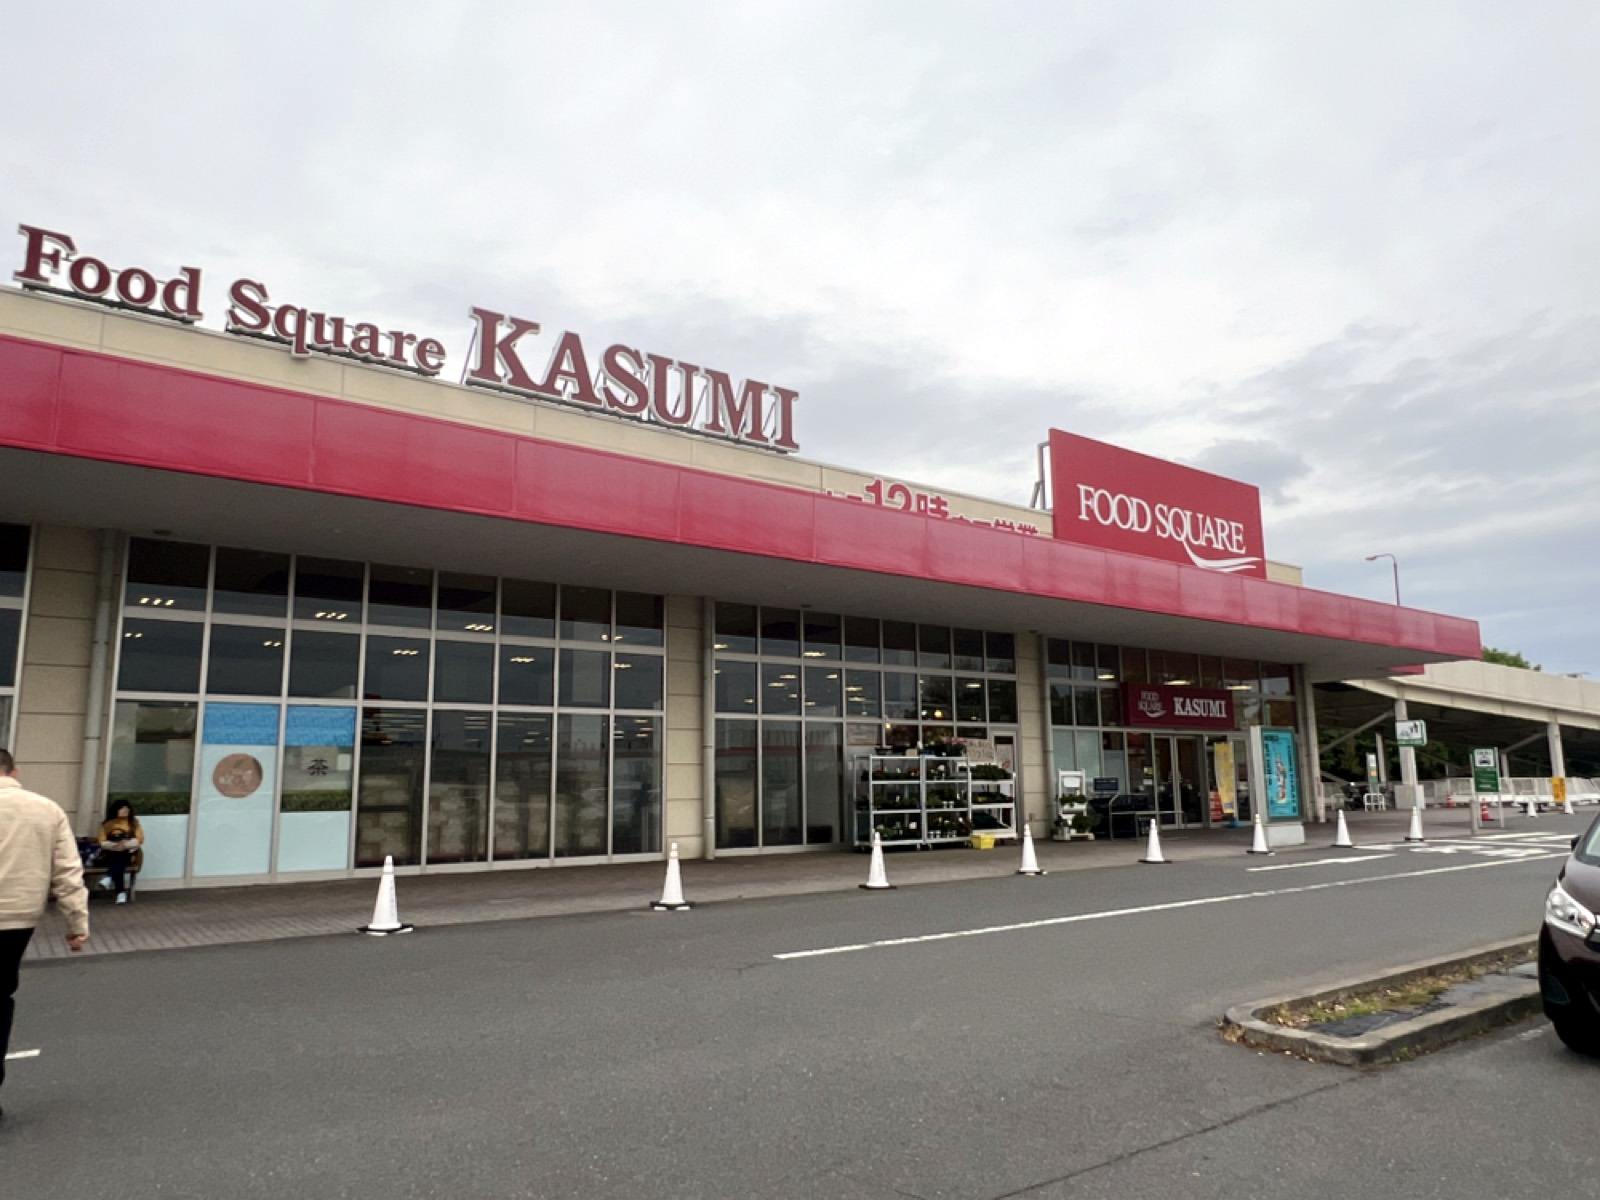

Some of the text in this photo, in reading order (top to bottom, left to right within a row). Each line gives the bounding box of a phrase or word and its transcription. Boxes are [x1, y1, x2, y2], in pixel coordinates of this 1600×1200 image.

[13, 223, 800, 453] Food Square KASUMI
[1077, 484, 1250, 560] FOOD SQUARE
[1173, 697, 1228, 718] KASUMI
[307, 757, 329, 777] 茶
